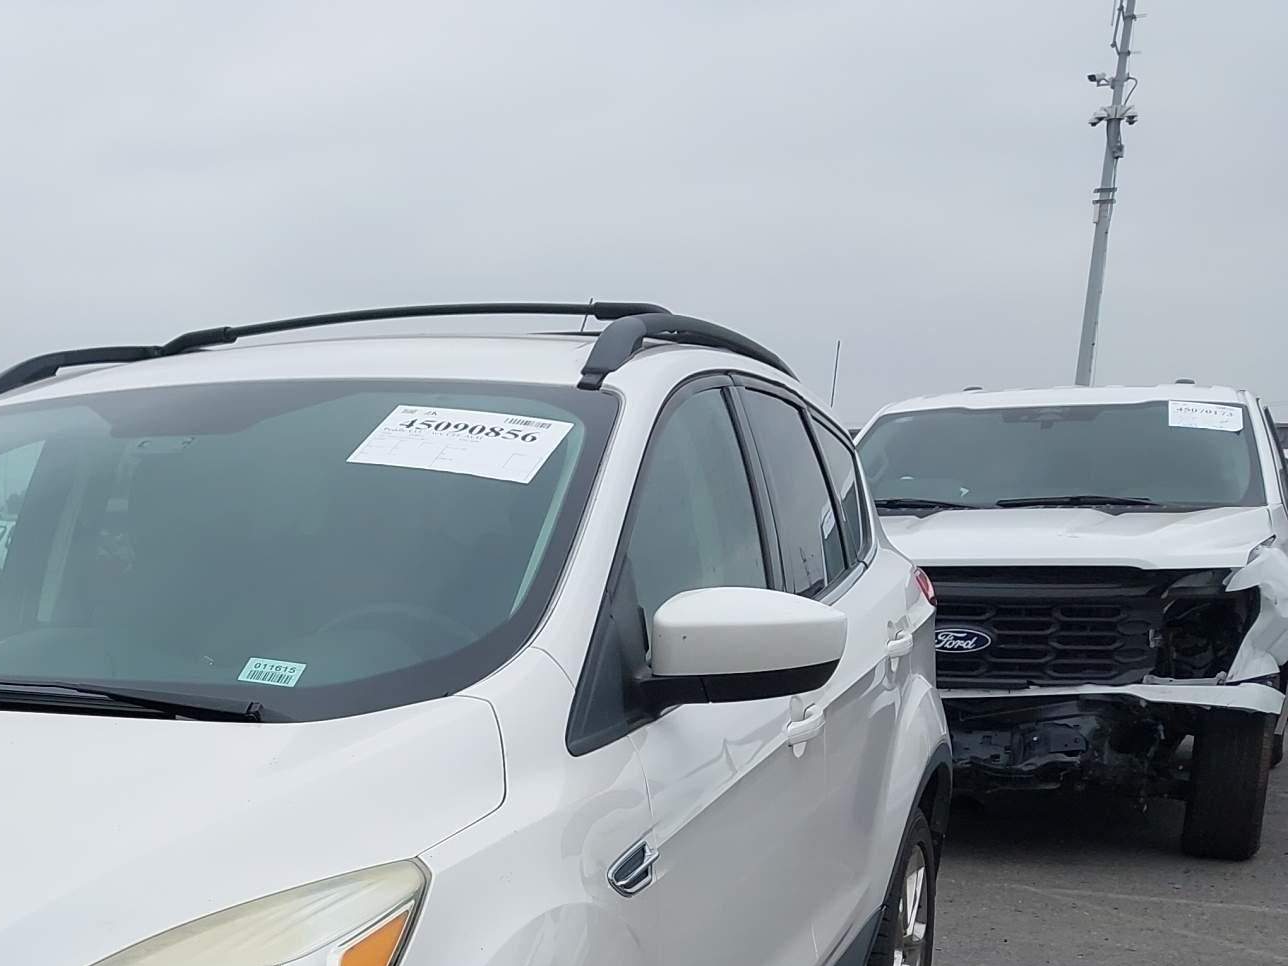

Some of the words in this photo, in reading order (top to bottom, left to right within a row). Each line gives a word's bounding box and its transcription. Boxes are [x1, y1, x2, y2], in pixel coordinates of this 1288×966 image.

[399, 418, 541, 443] 45090856
[935, 632, 978, 649] Ford
[254, 662, 297, 674] 011615
